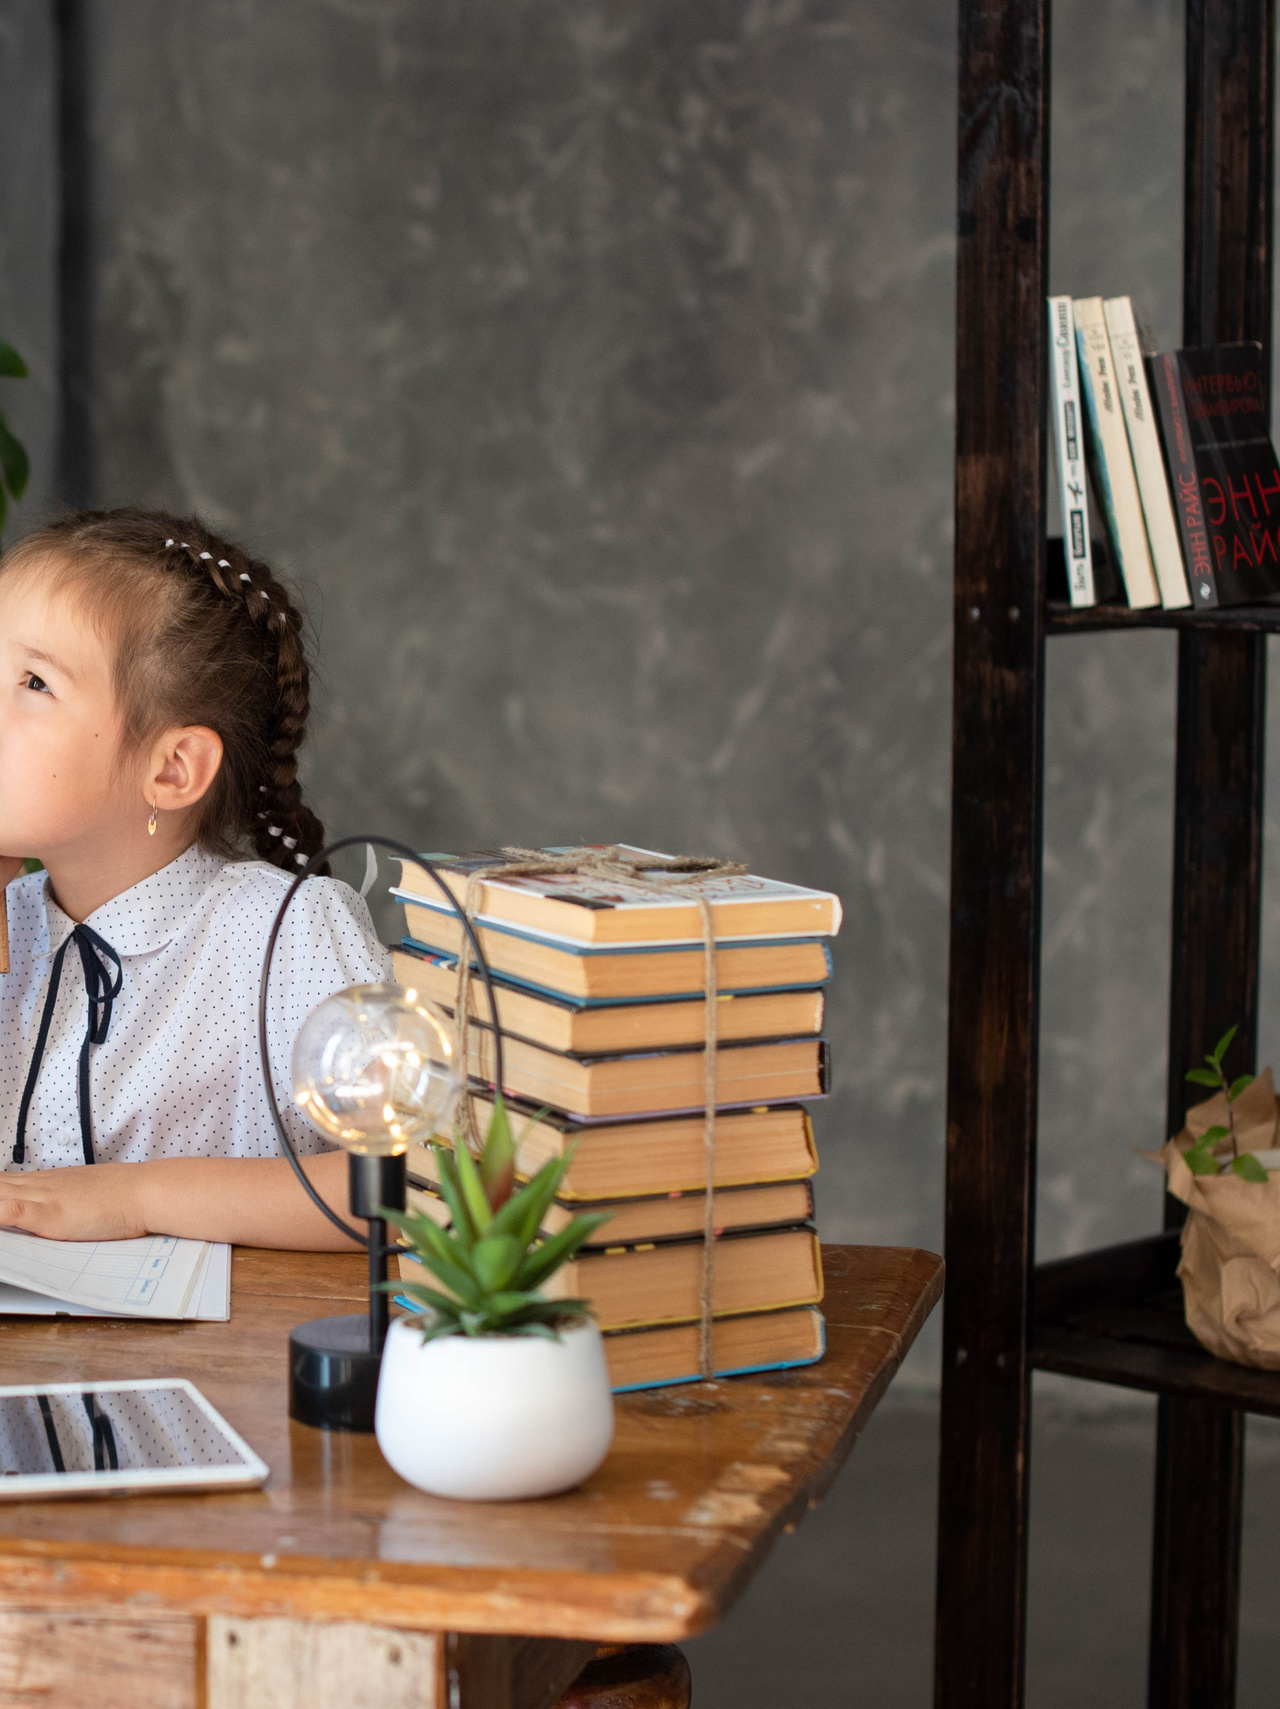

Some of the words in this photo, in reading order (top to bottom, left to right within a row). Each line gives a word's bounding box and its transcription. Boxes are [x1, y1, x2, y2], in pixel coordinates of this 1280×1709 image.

[1179, 472, 1203, 527] РАЙС
[1203, 469, 1280, 526] ЭНН
[1189, 531, 1211, 576] ЭНН
[1213, 521, 1280, 572] РАЙ
